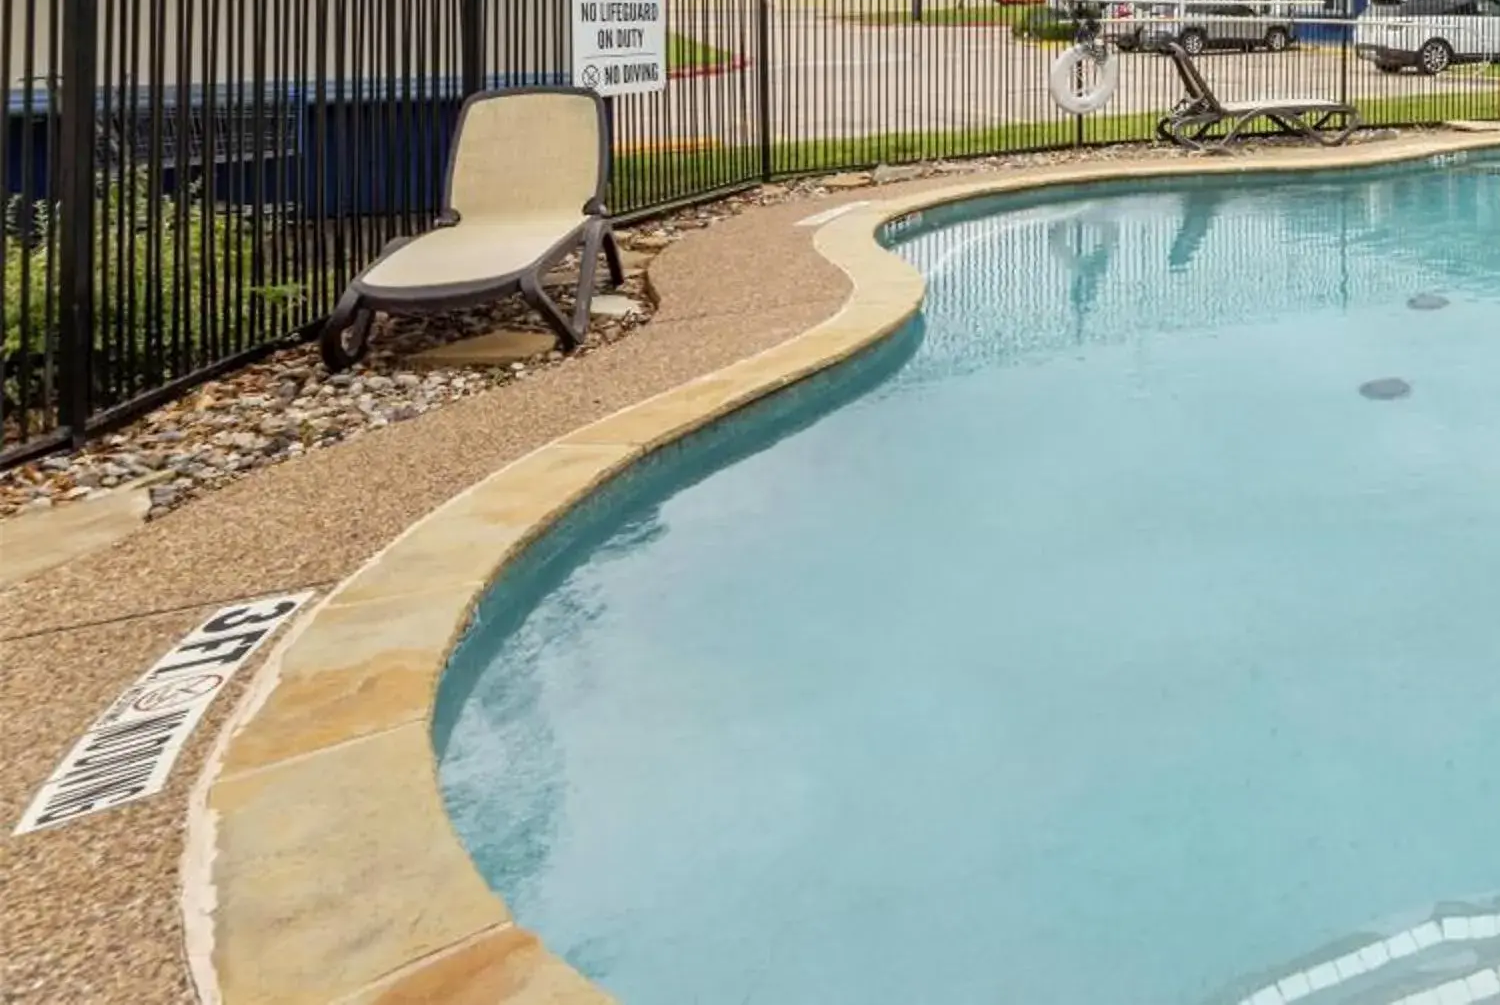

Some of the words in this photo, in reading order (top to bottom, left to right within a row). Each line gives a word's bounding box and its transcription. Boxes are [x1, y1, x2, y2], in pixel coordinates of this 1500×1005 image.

[581, 2, 597, 22] NO
[600, 2, 659, 23] LIFEGUARD
[597, 29, 613, 50] ON
[617, 28, 644, 48] DUTY
[605, 64, 620, 86] NO
[623, 62, 659, 85] DIVING
[202, 601, 296, 633] 3
[153, 628, 270, 676] FT
